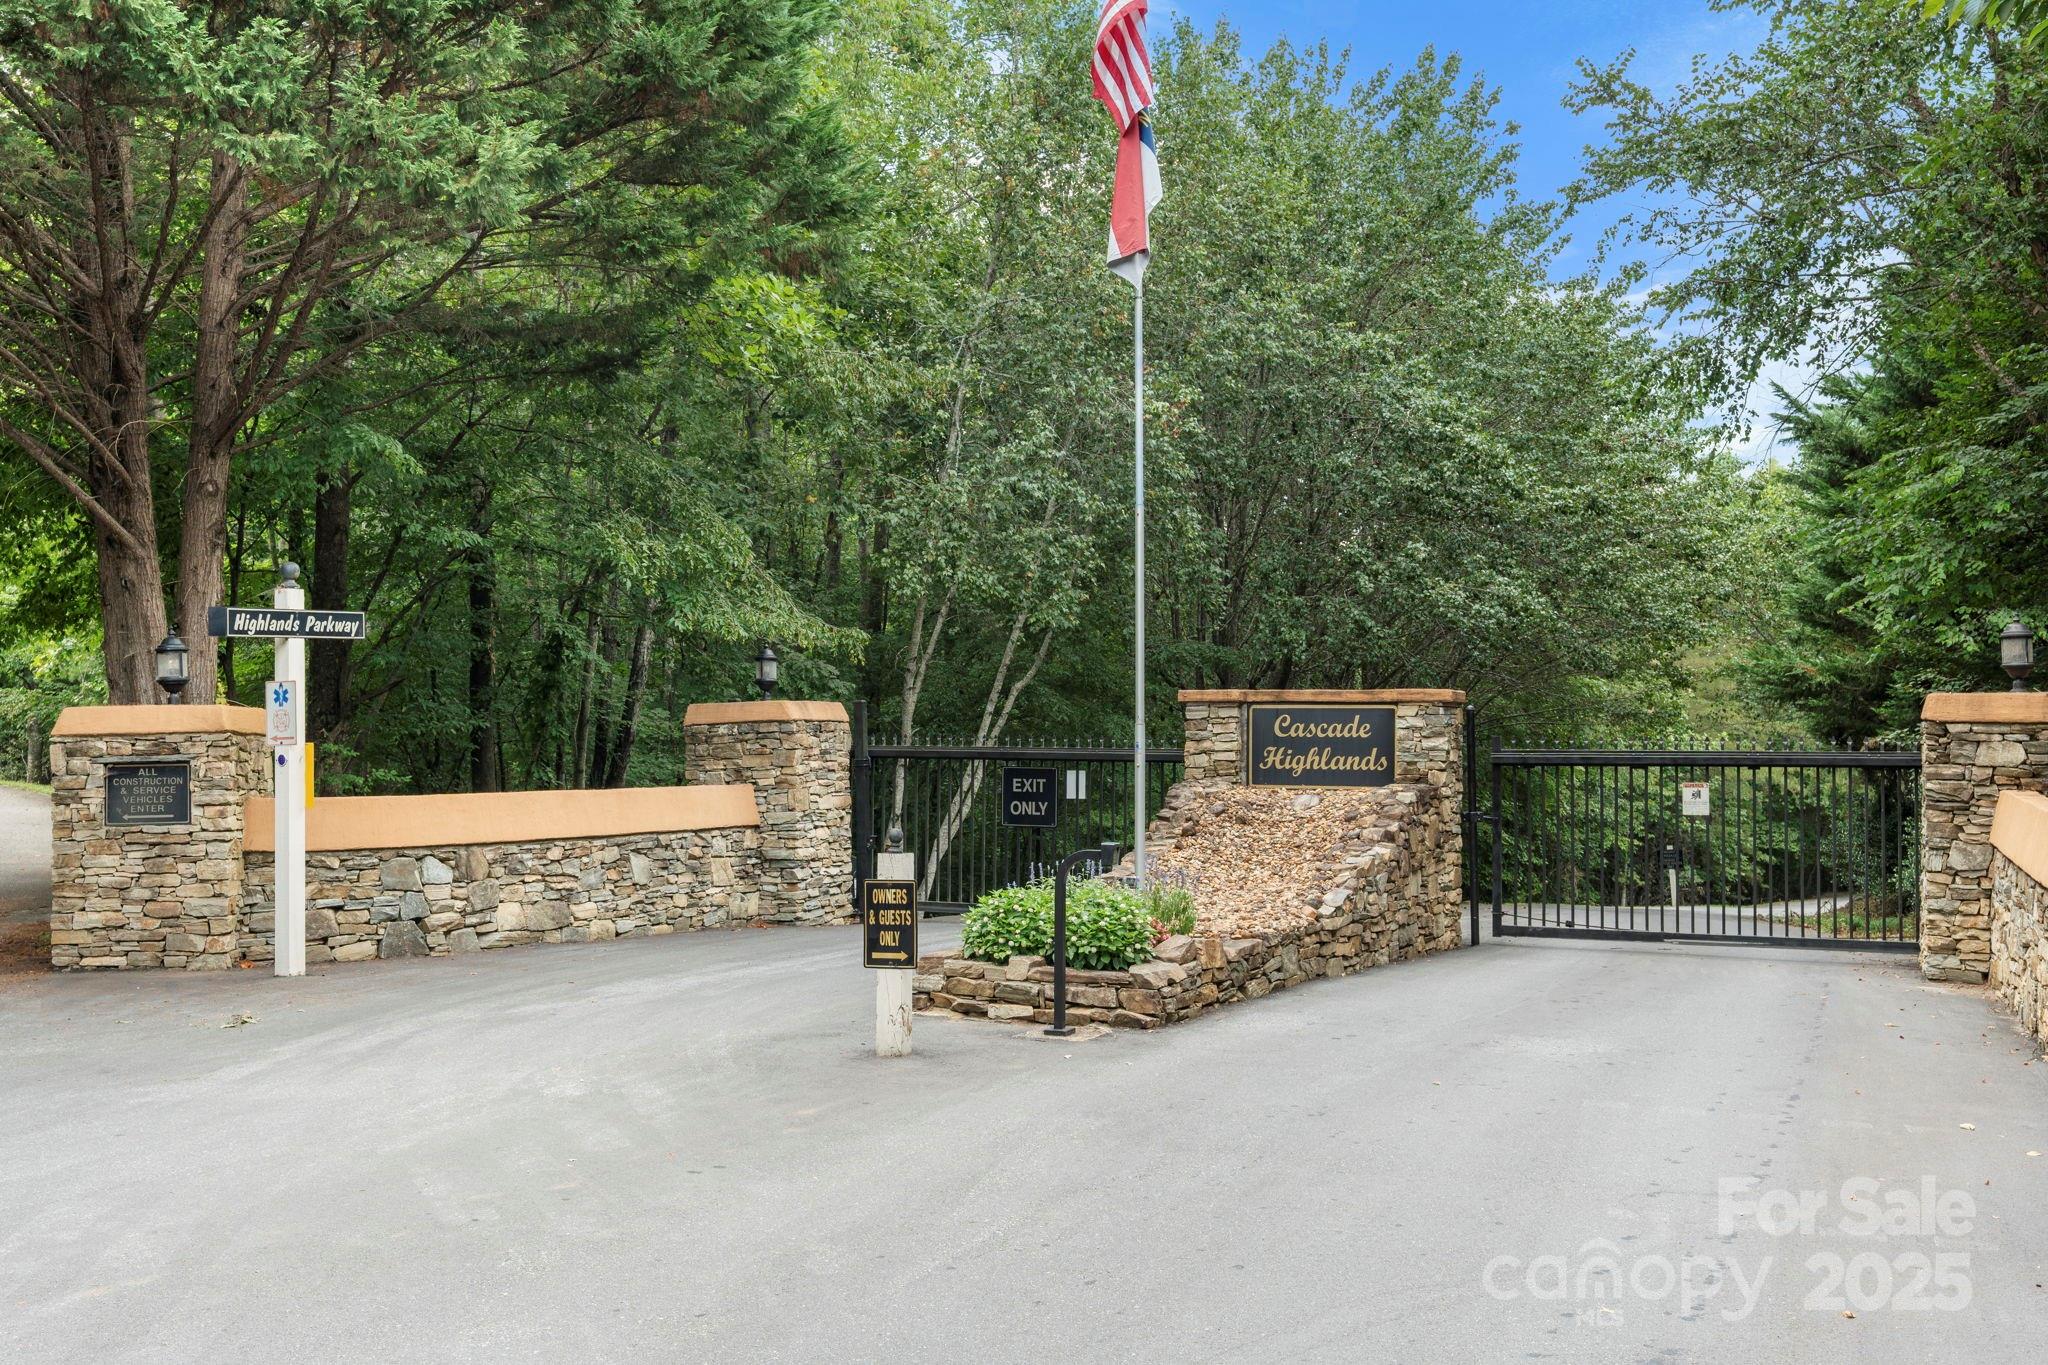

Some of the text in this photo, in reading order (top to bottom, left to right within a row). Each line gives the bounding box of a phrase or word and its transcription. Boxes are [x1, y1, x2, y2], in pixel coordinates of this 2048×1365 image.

[233, 613, 359, 637] Highlands Parkway
[1273, 713, 1372, 738] Cascade
[1259, 746, 1388, 777] Highlands
[138, 768, 158, 776] ALL
[113, 777, 183, 786] CONSTRUCTION
[1012, 778, 1046, 793] EXIT
[120, 786, 176, 795] & SERVICE
[123, 795, 173, 804] VEHICLES
[130, 805, 165, 813] ENTER
[1010, 801, 1048, 816] ONLY
[872, 888, 907, 905] OWNERS
[869, 910, 912, 926] & GUESTS
[879, 930, 900, 947] ONLY
